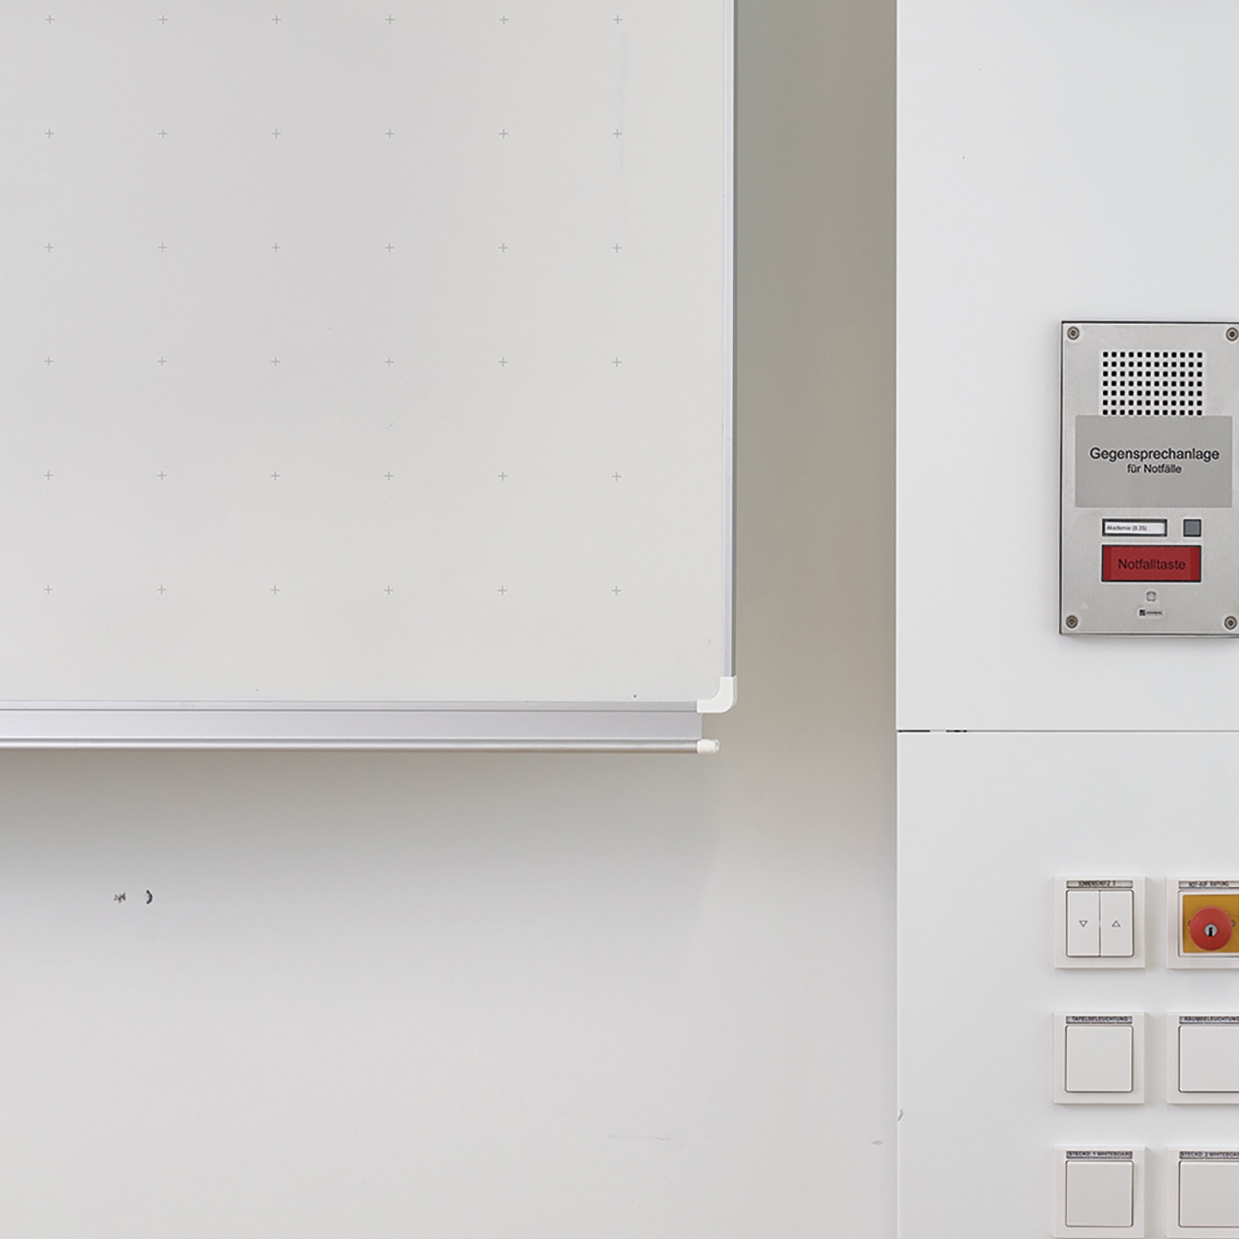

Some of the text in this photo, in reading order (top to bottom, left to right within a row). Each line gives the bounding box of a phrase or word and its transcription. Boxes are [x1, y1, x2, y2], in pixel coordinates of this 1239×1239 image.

[1089, 447, 1220, 462] Gegensprechanlage
[1127, 463, 1182, 473] für Notfälle
[1118, 558, 1187, 570] Notfalltaste
